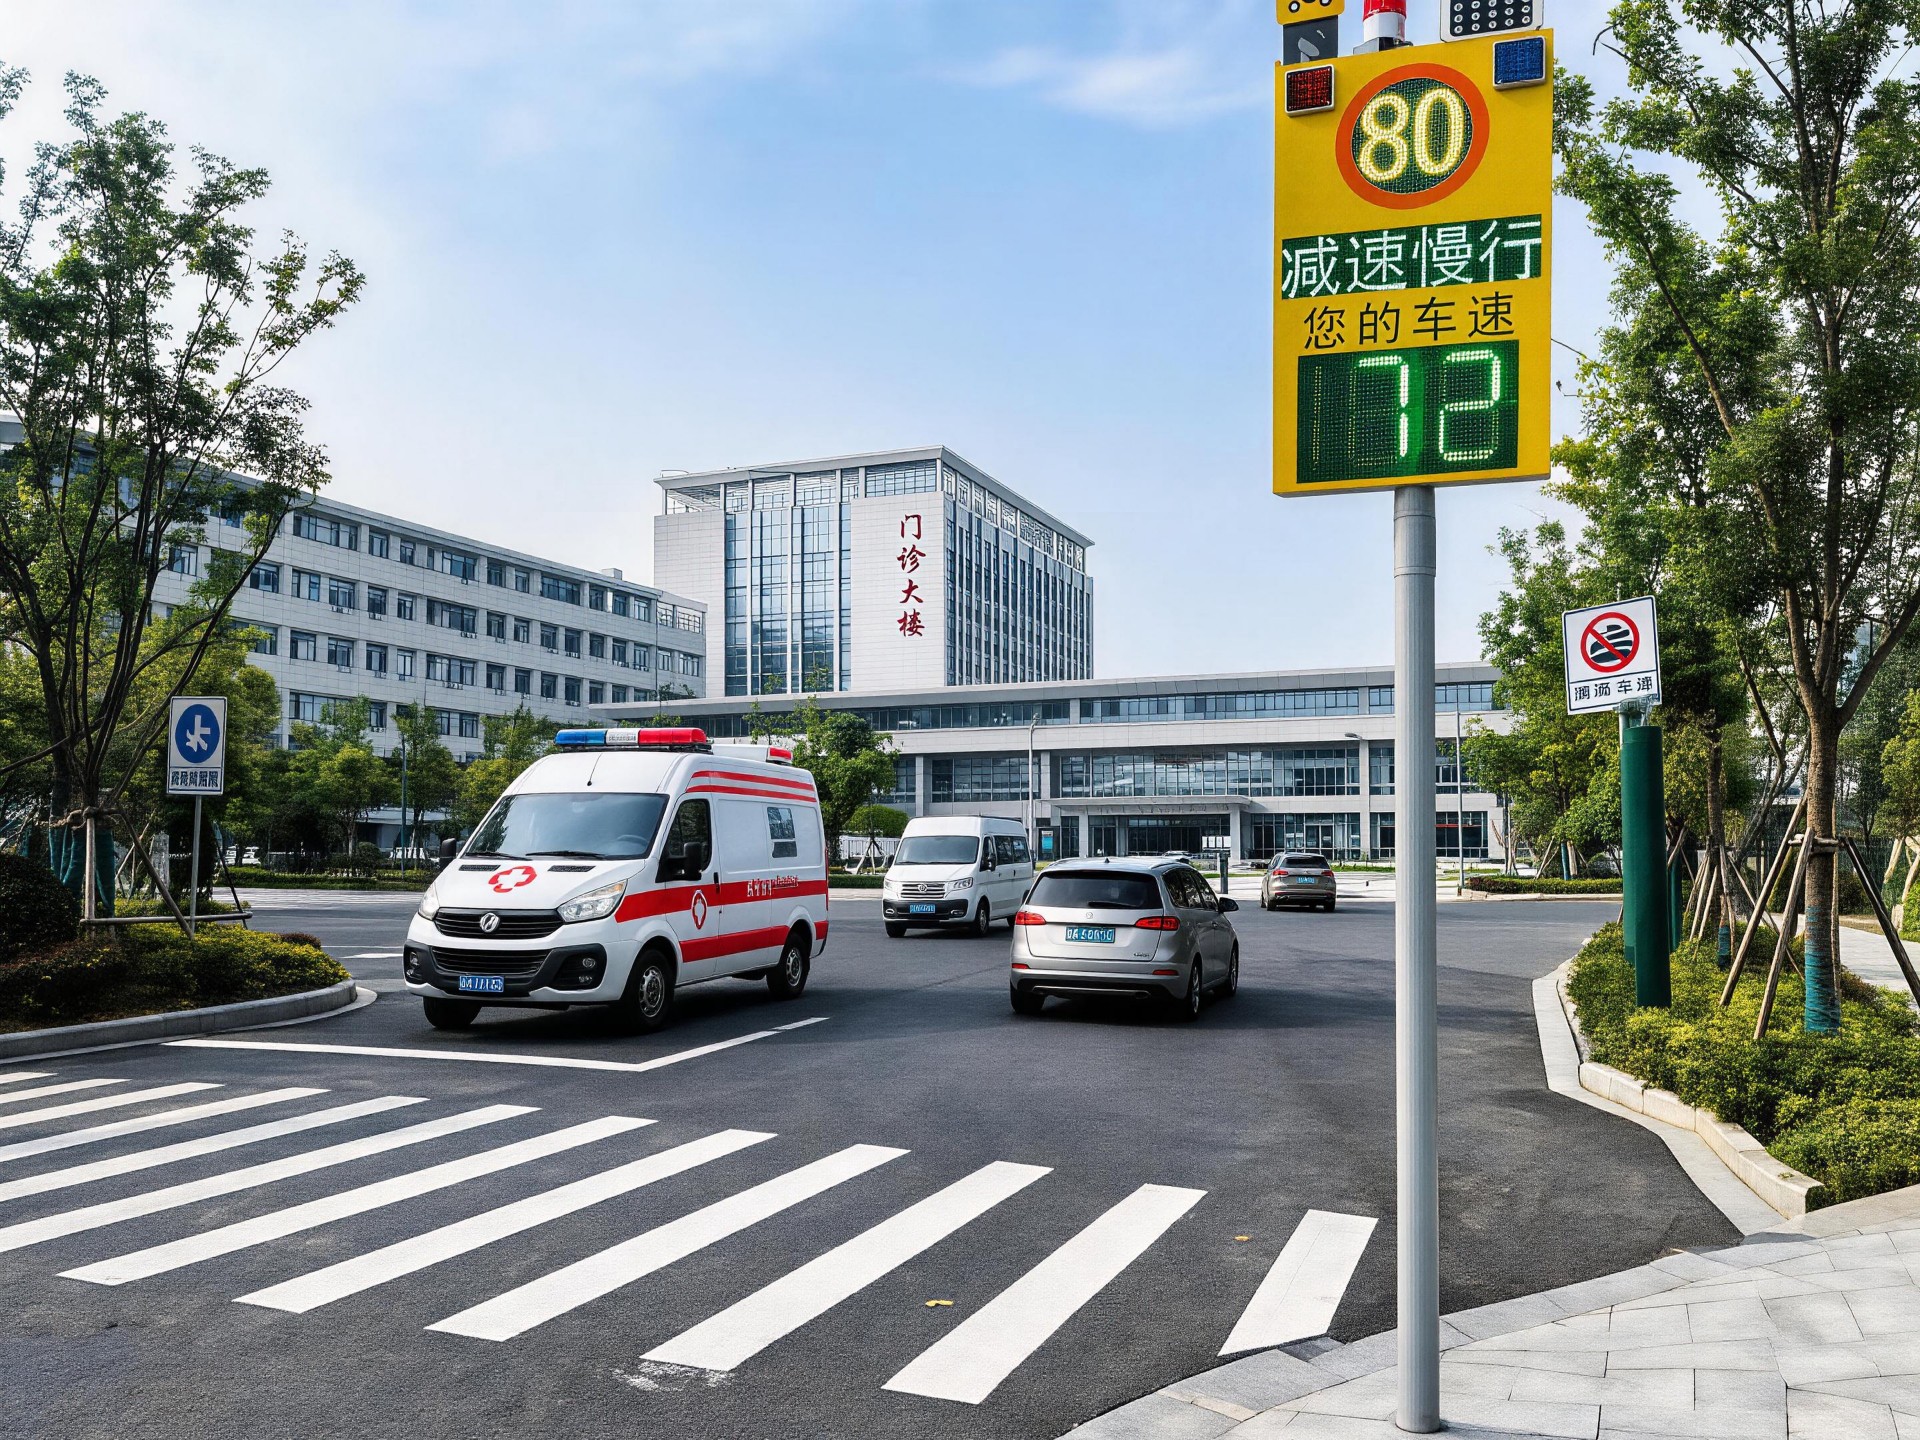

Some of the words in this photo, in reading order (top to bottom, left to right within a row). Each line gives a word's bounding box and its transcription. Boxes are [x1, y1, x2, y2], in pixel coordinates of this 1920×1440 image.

[1358, 87, 1464, 182] 80
[1281, 220, 1542, 299] 减速慢行
[1303, 291, 1515, 350] 您的车速
[1358, 349, 1501, 462] 72
[896, 513, 927, 638] 门诊大楼
